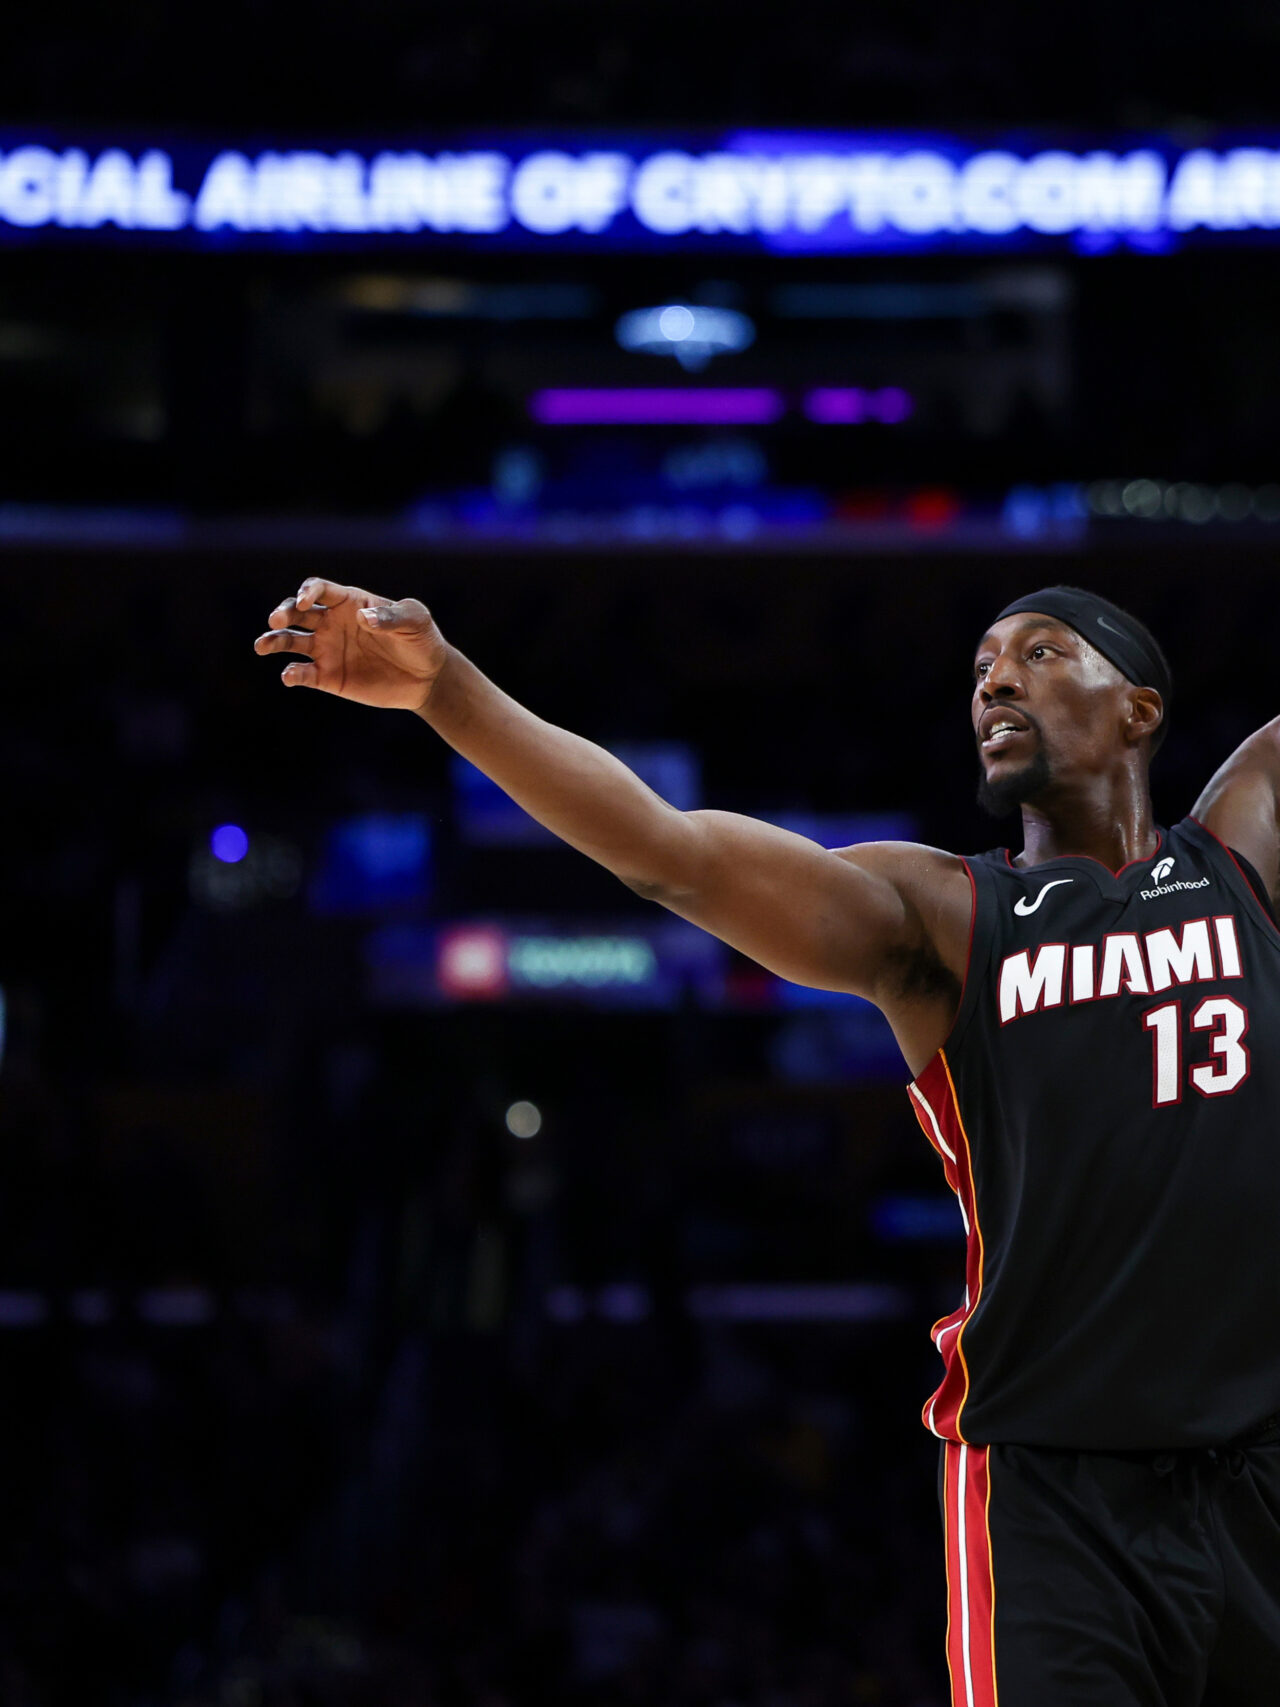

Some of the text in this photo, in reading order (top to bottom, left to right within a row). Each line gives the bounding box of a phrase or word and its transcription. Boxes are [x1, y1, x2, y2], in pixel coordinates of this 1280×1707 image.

[195, 150, 504, 232] AIRLINE
[510, 150, 630, 234] OF
[1140, 877, 1210, 900] Robinhood
[997, 915, 1243, 1028] MIAMI
[1142, 994, 1250, 1109] 13
